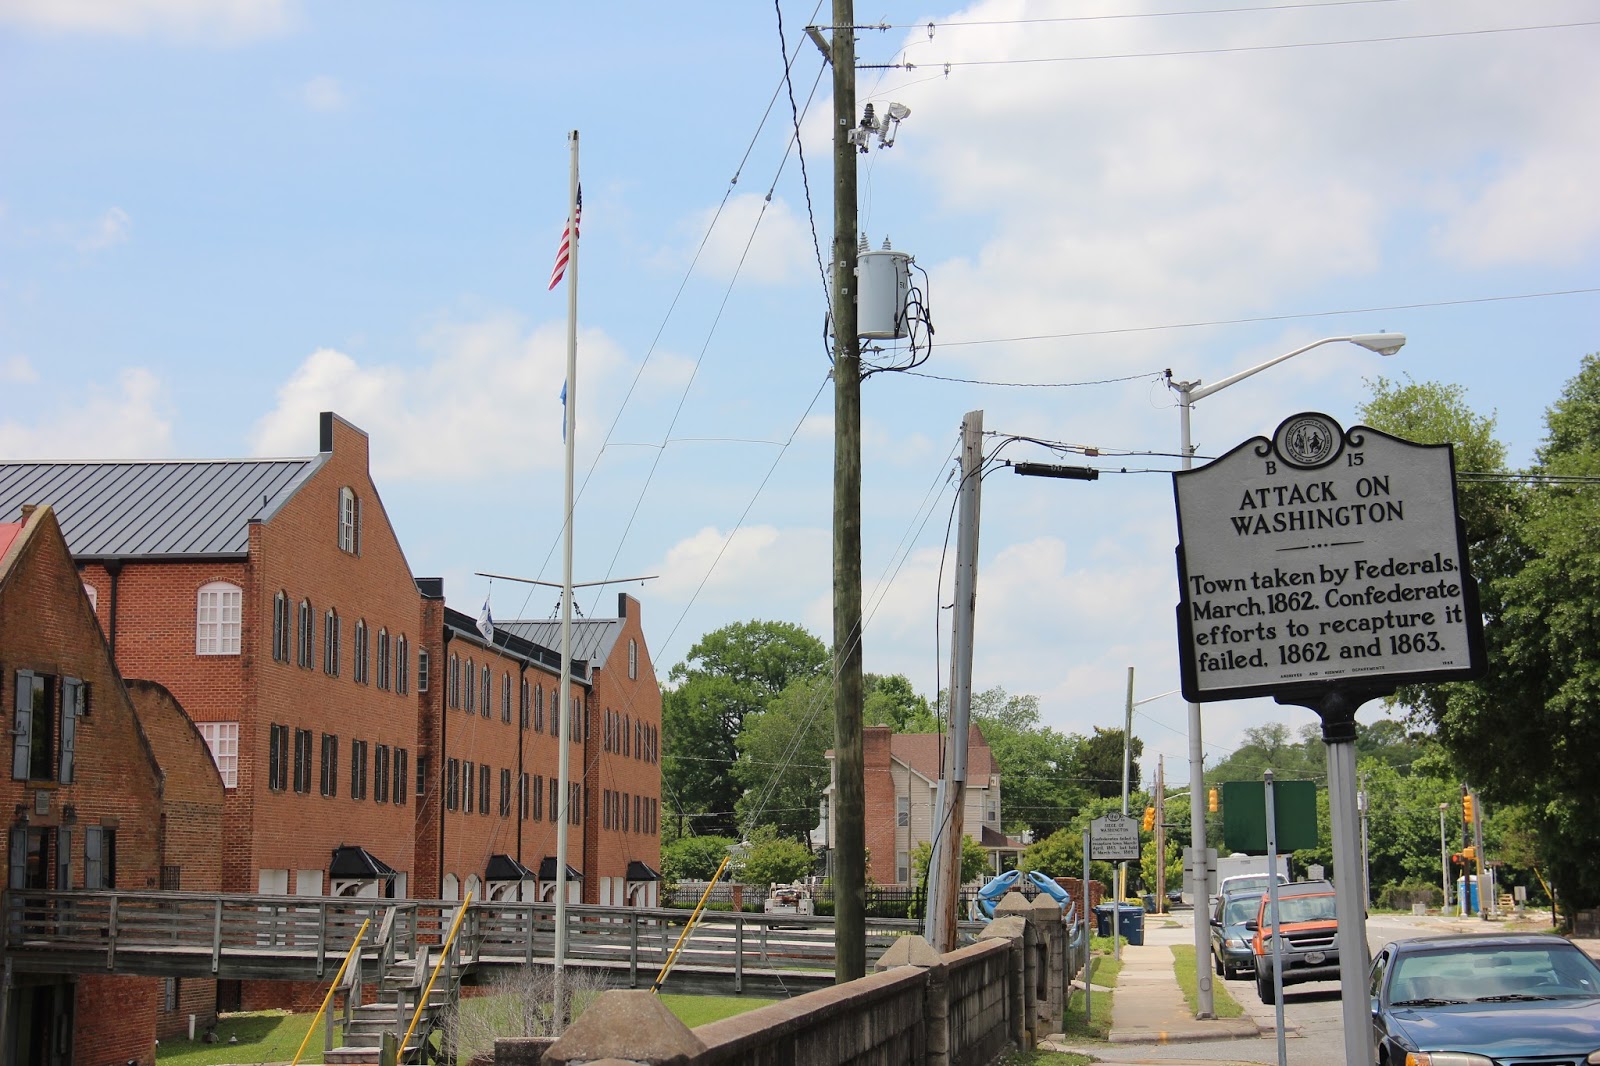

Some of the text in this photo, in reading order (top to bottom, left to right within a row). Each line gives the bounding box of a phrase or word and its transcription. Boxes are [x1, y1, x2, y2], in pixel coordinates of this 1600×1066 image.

[1266, 452, 1364, 475] B 15
[1239, 475, 1390, 510] ATTACK ON
[1231, 501, 1404, 537] WASHINGTON
[1190, 553, 1459, 595] Town taken by Federals,
[1192, 580, 1461, 621] March, 1862. Confederate
[1196, 605, 1463, 646] efforts to recapture it
[1198, 630, 1446, 672] failed, 1862 and 1863.
